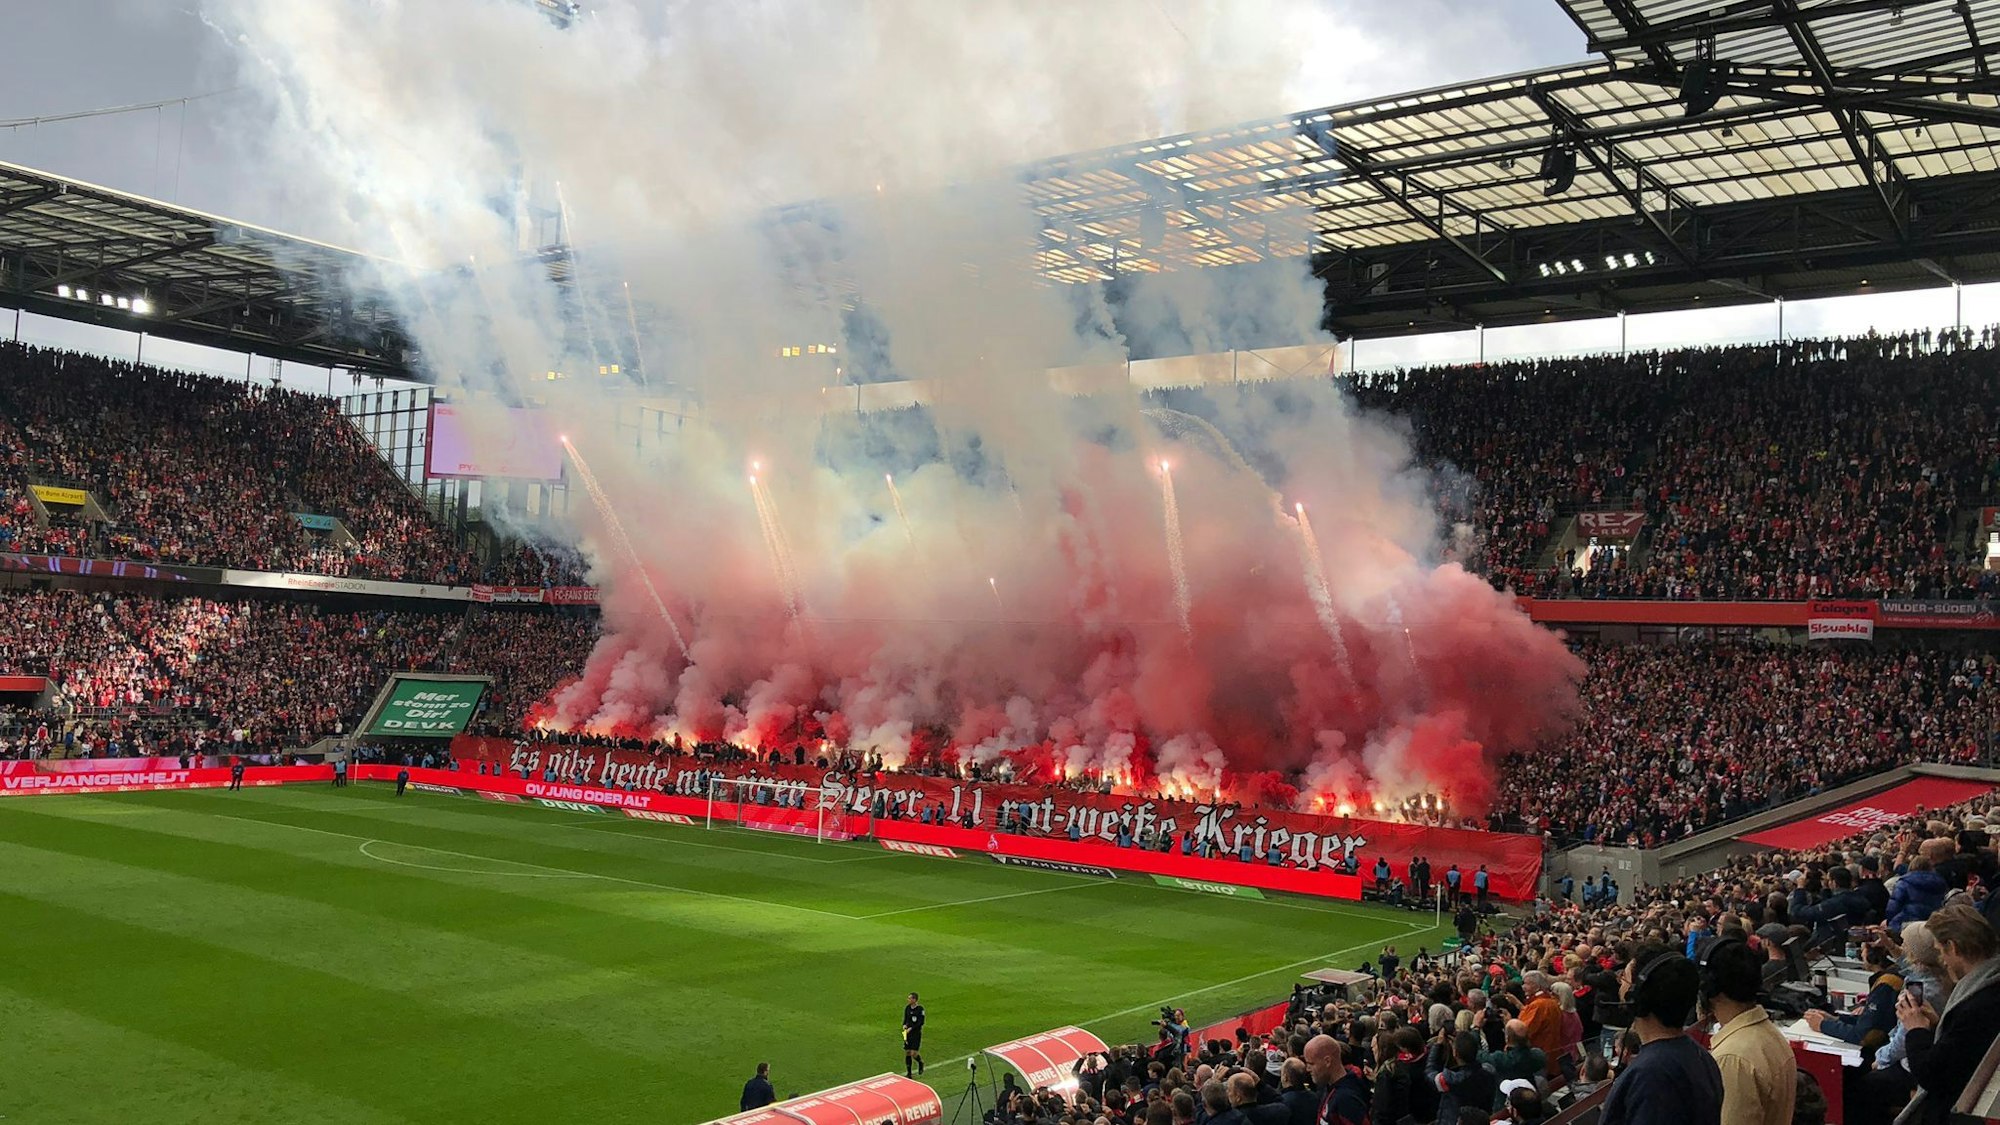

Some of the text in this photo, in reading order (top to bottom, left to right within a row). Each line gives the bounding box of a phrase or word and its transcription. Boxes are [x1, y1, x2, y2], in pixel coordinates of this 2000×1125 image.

[61, 491, 83, 499] Airport
[554, 589, 582, 600] FC-FANS
[1812, 603, 1868, 615] Cologne
[1882, 602, 1977, 614] WILDER-SÜDEN
[1811, 623, 1868, 634] Slovakia
[413, 691, 460, 701] Mer
[405, 709, 452, 719] Dir!
[383, 720, 456, 729] DEVK
[4, 771, 190, 789] VERJANGENHEJT
[525, 783, 651, 808] OV JUNG ODER ALT
[510, 740, 541, 772] Es
[548, 749, 596, 783] gibt
[599, 751, 671, 792] heute
[814, 771, 925, 820] Sieger
[1193, 804, 1367, 871] Krieger
[540, 800, 596, 813] DEVK
[1058, 1059, 1080, 1074] REW
[1028, 1067, 1057, 1084] REWE
[866, 1077, 901, 1089] REWE
[825, 1087, 864, 1101] REWE
[905, 1100, 937, 1122] REWE
